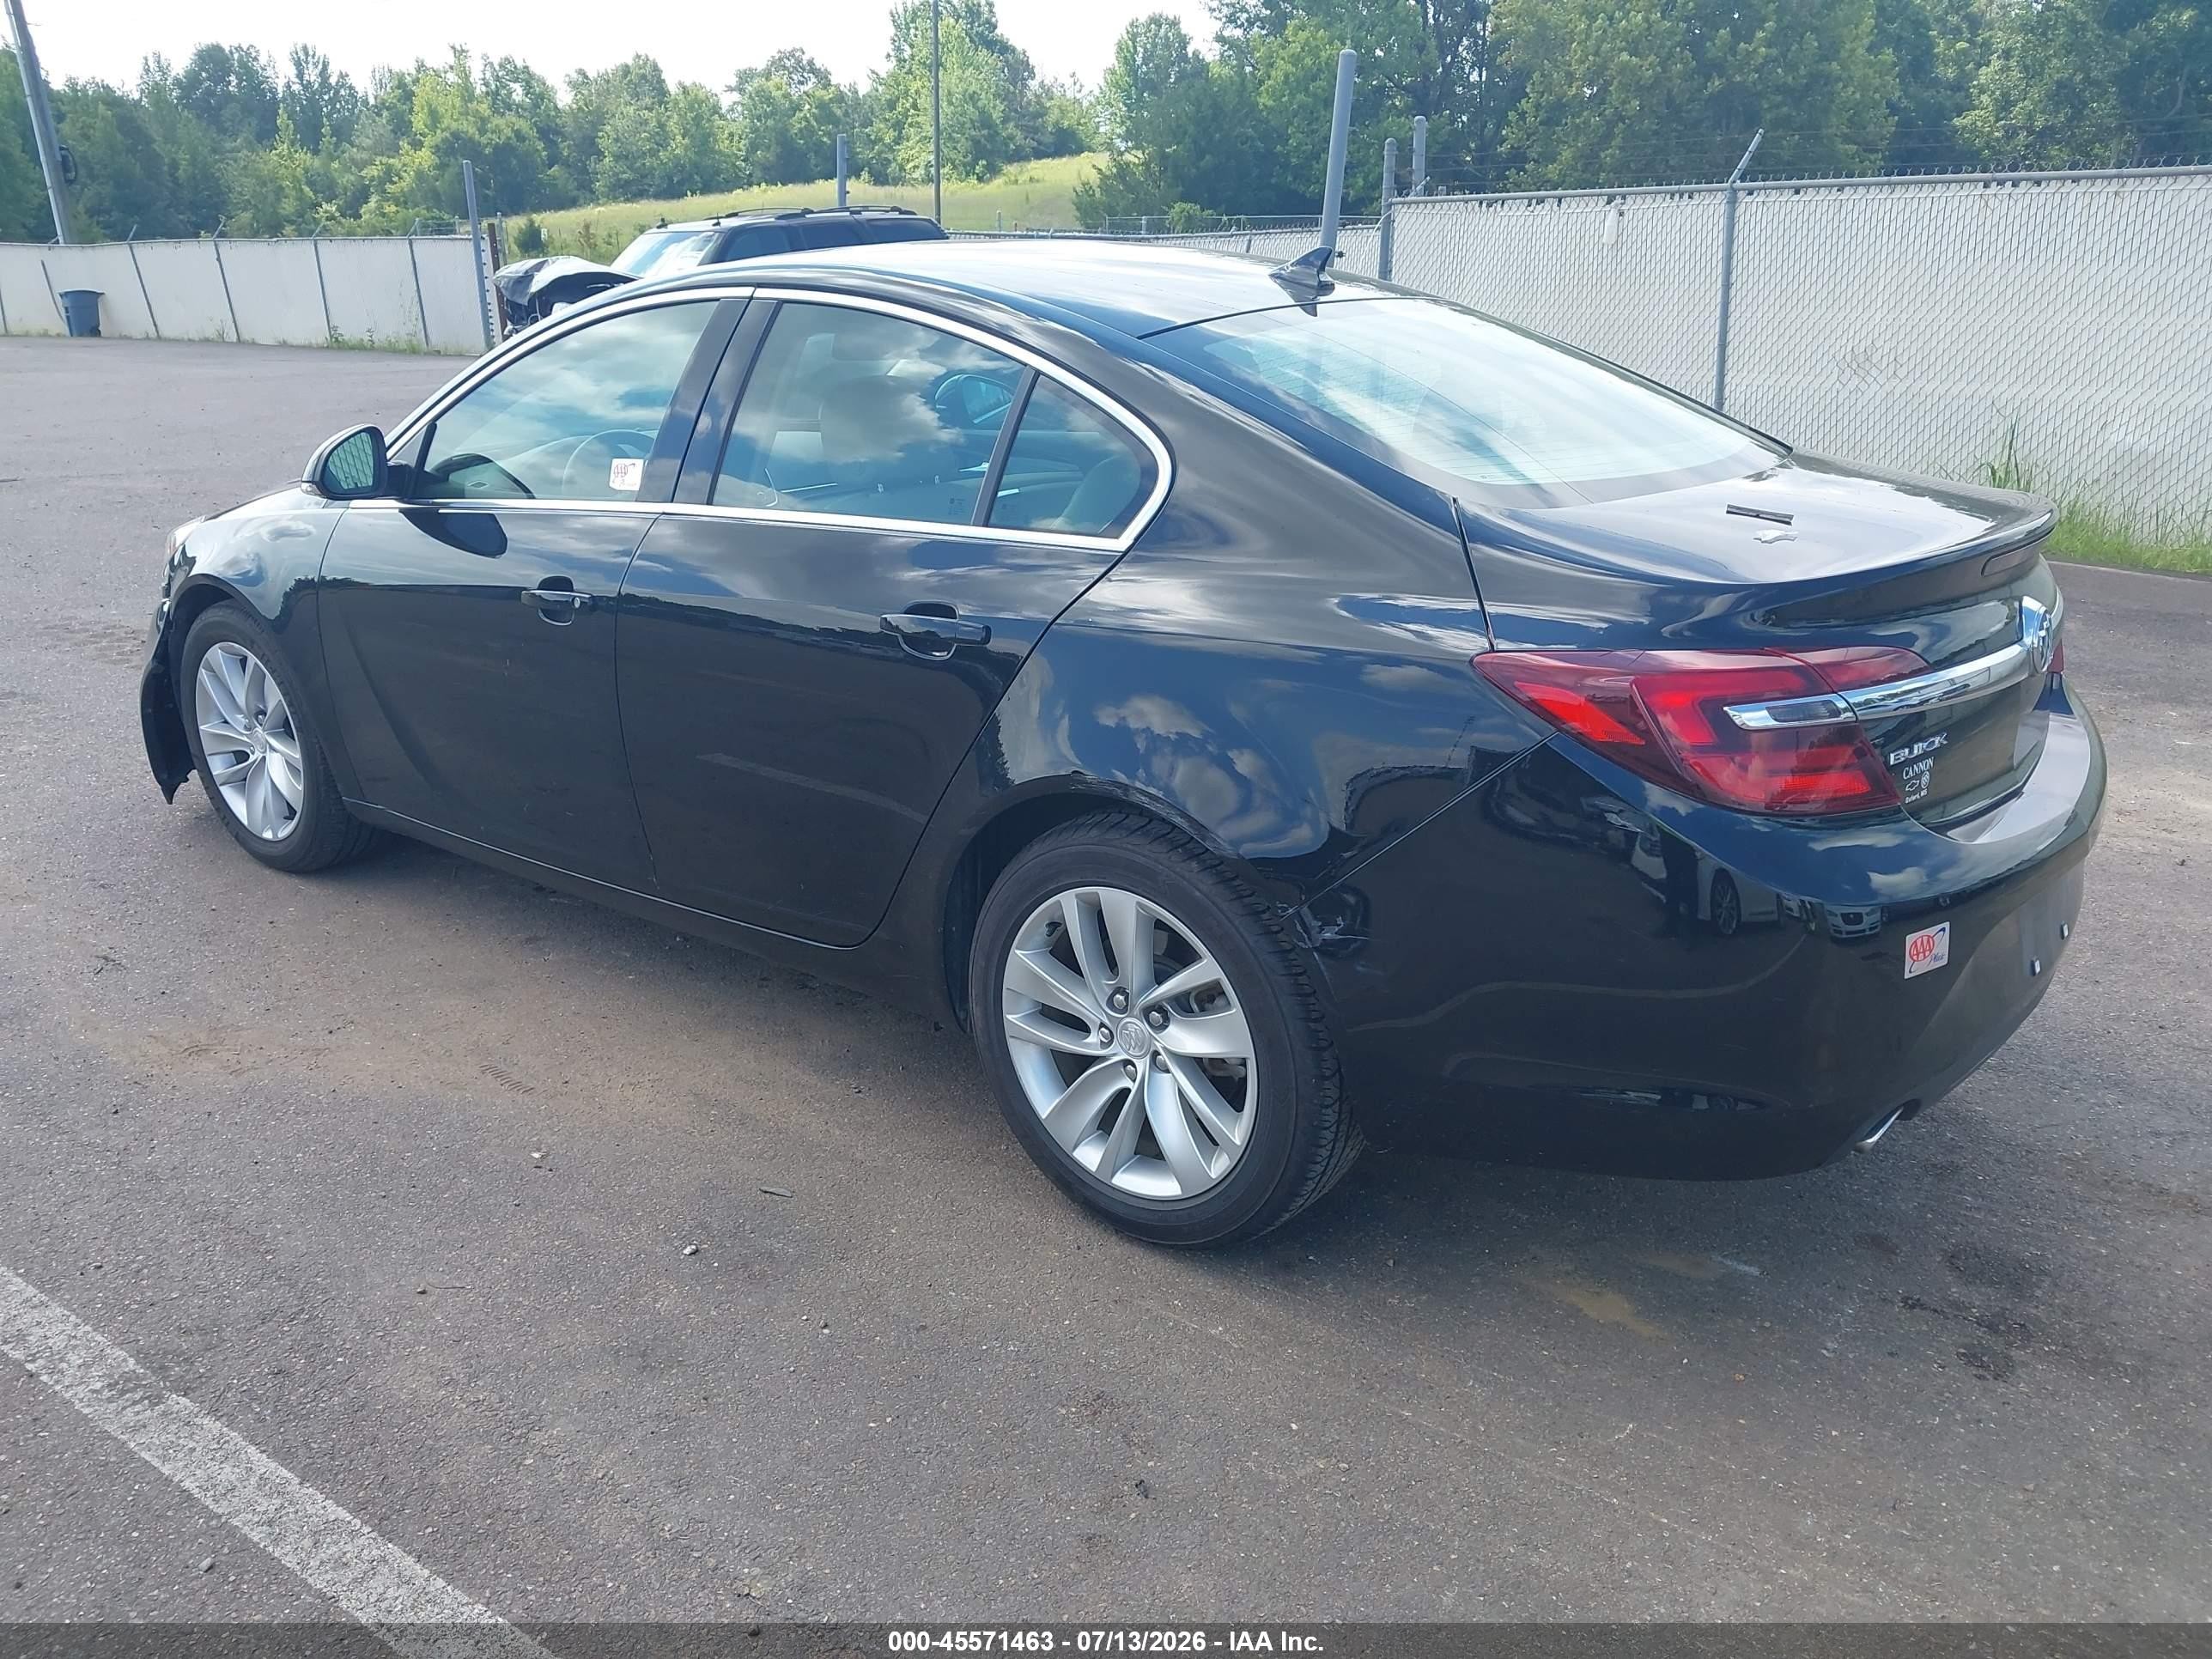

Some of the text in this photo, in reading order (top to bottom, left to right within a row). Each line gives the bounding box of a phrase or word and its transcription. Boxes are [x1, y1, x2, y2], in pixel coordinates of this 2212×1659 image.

[1889, 732, 1948, 765] BUICK
[1903, 757, 1934, 779] CANNON
[1909, 935, 1935, 961] AAA
